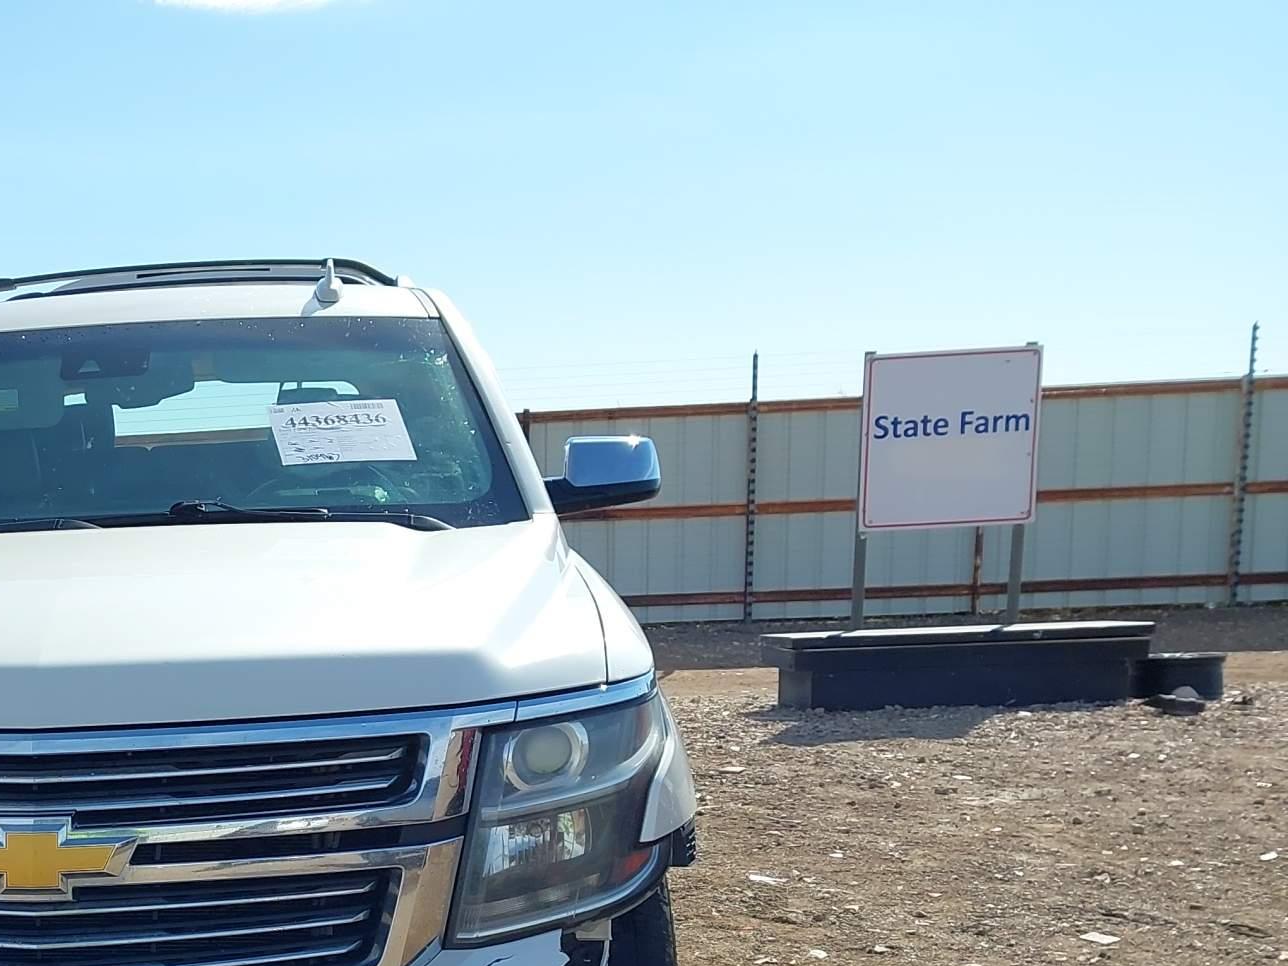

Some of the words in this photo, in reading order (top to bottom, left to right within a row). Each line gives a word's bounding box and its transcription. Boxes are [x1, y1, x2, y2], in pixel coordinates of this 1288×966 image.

[284, 413, 387, 428] 44368436
[873, 415, 950, 440] State
[960, 411, 1030, 435] Farm
